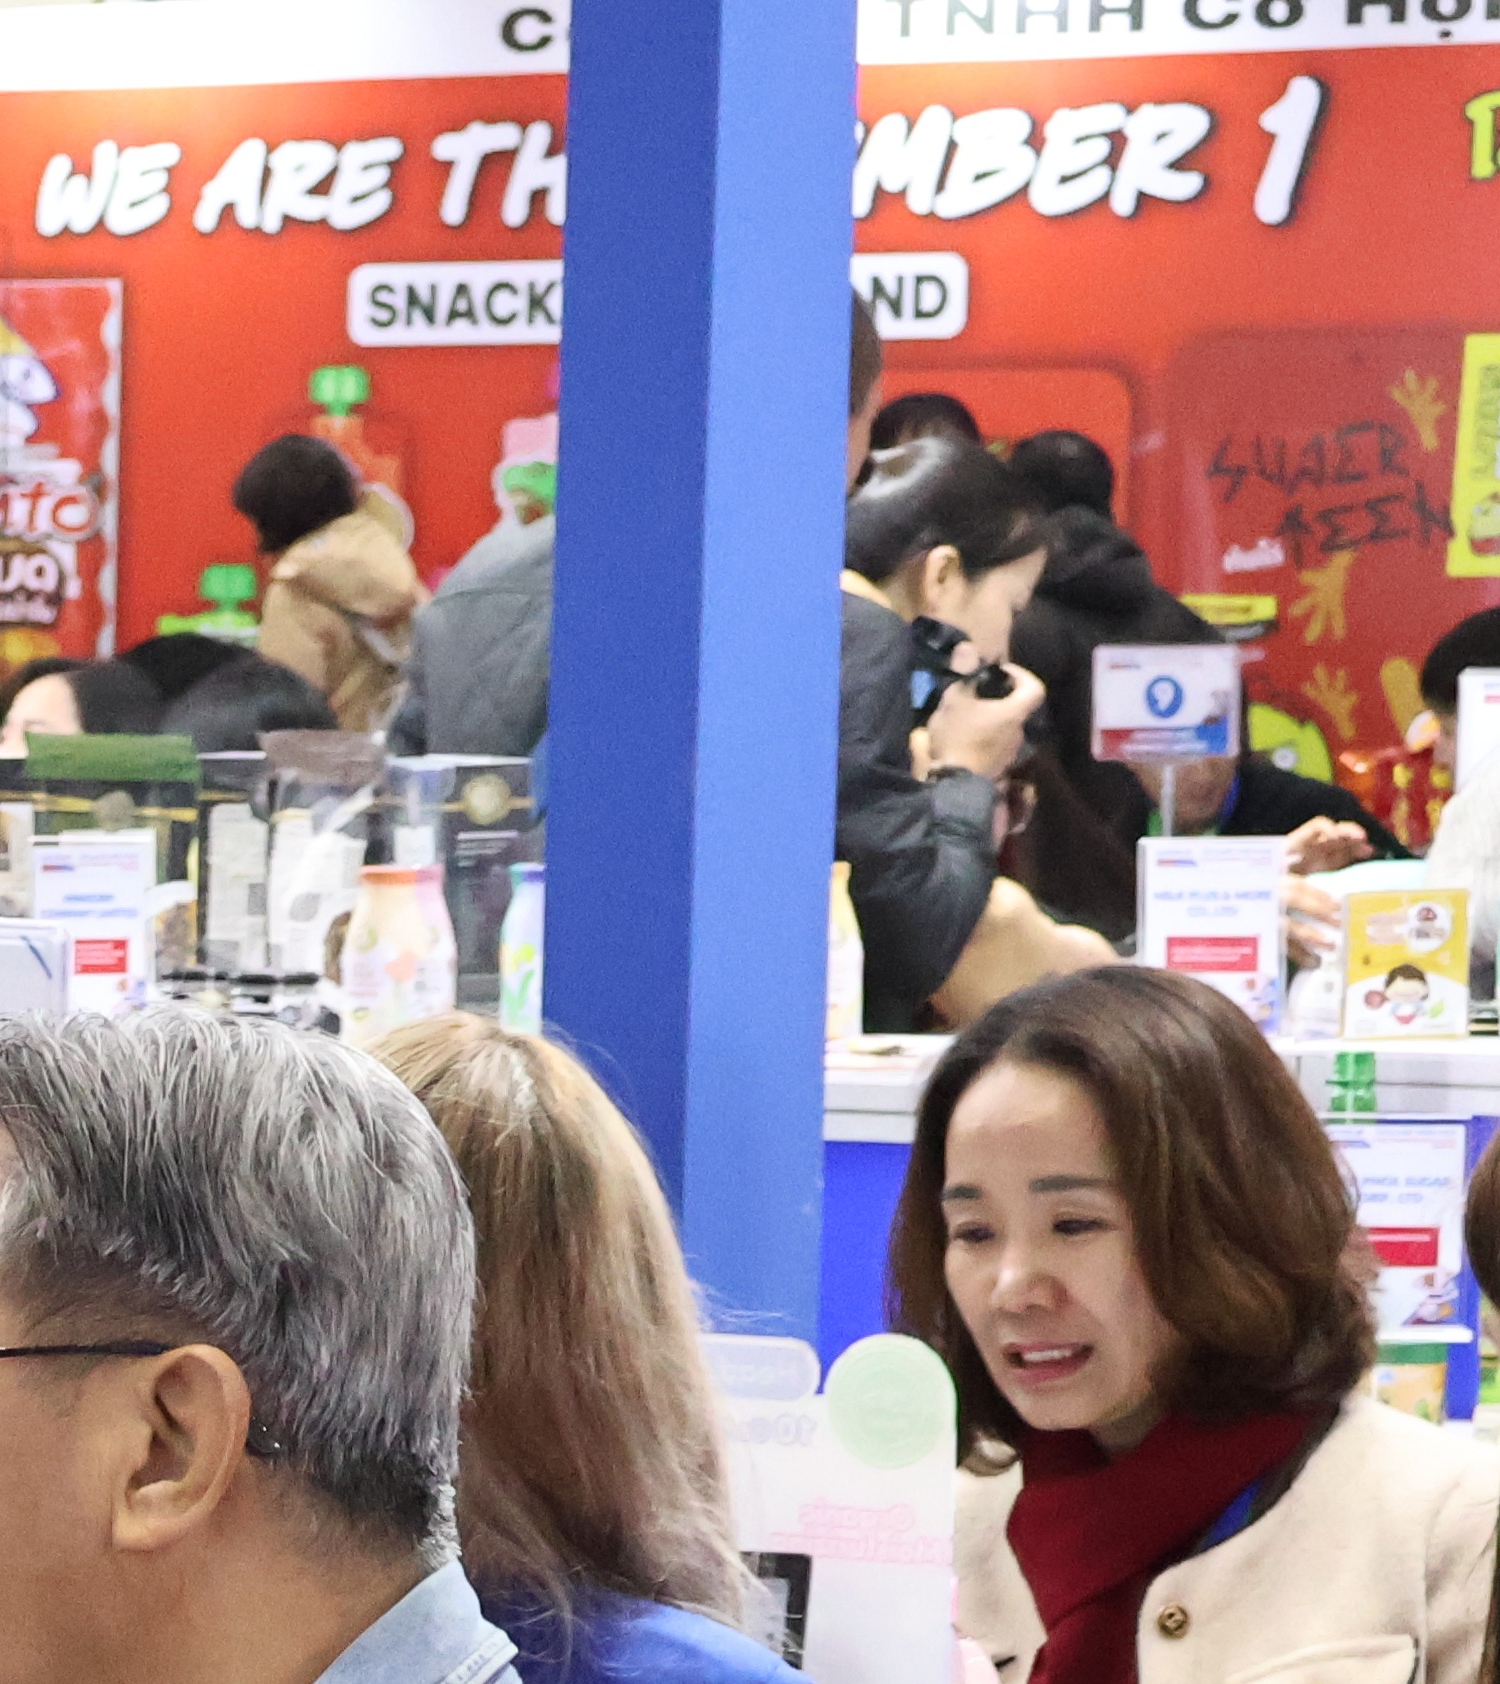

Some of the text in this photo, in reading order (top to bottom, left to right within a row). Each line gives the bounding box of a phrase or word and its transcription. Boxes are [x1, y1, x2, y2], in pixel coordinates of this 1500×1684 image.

[36, 120, 566, 238] WE ARE TH
[852, 102, 1214, 221] MBER
[1253, 75, 1324, 226] 1
